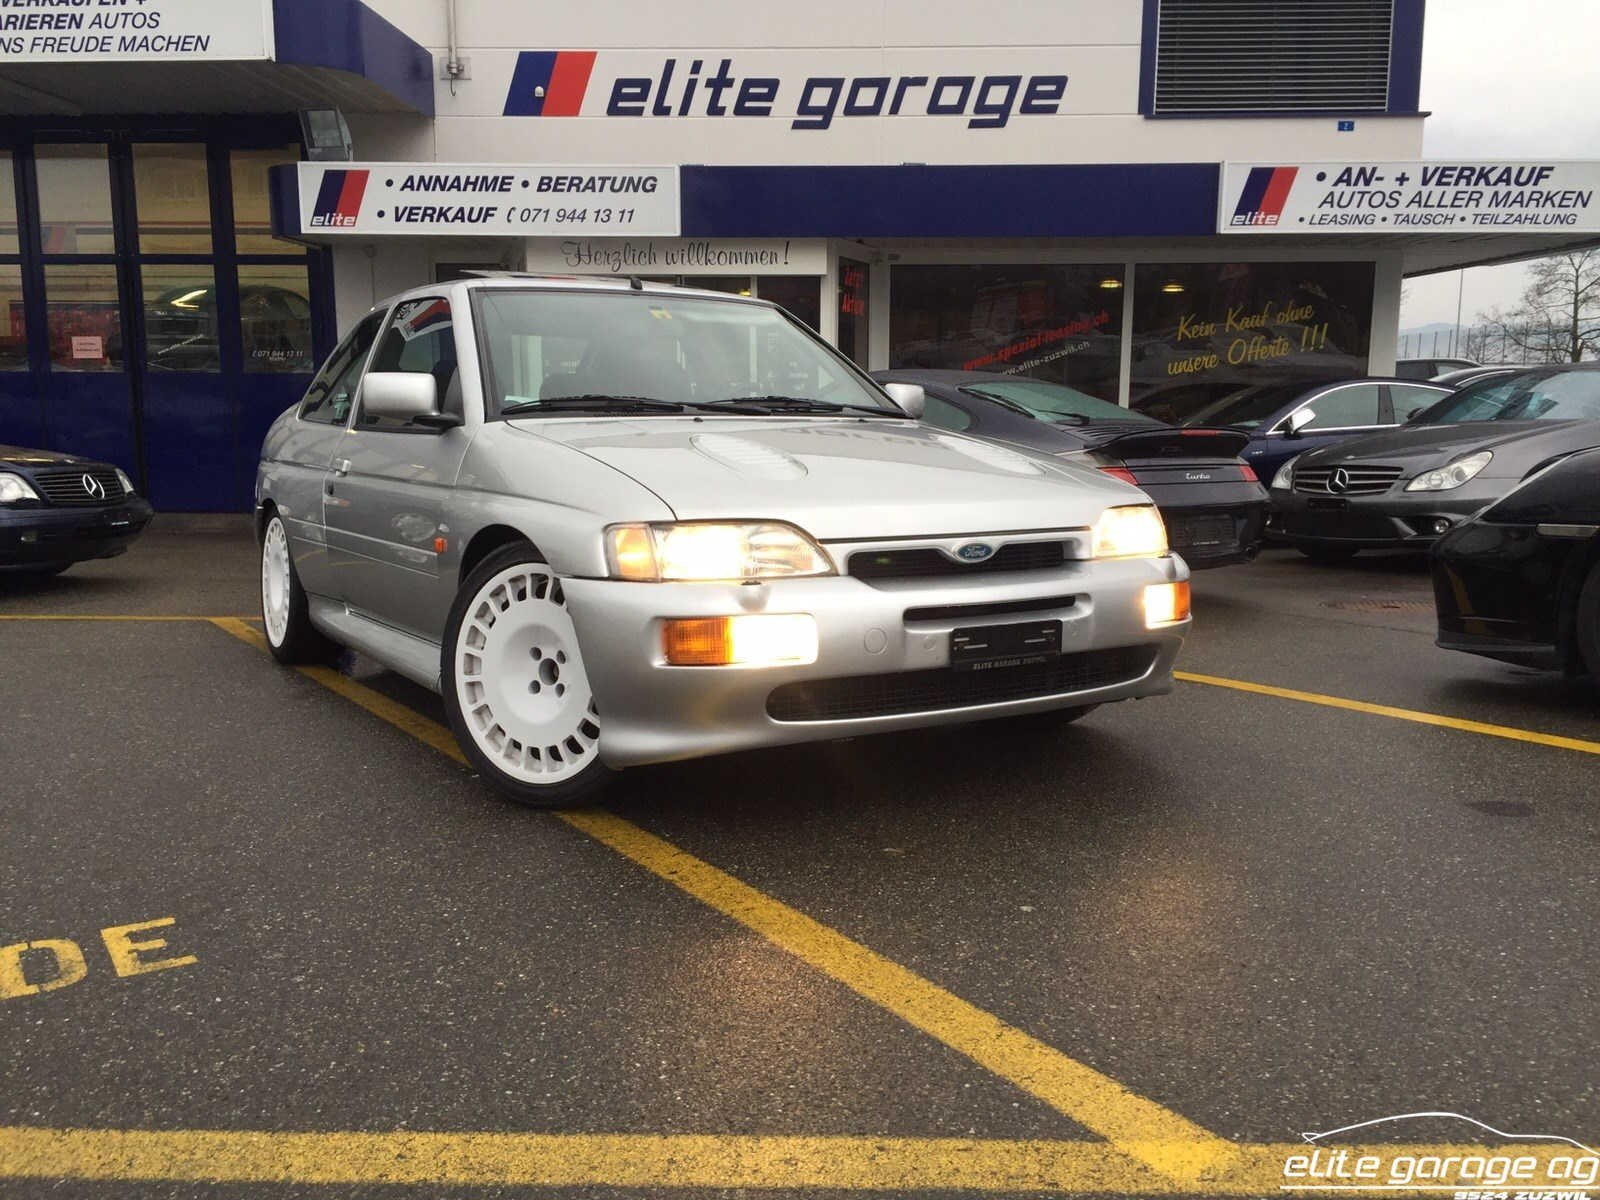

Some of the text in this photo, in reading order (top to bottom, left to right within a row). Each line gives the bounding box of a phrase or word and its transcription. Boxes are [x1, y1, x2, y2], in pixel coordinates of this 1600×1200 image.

[0, 12, 160, 30] RIEREN AUTOS
[29, 36, 113, 53] FREUDE
[117, 35, 210, 52] MACHEN
[606, 58, 1069, 130] elite garage
[400, 174, 658, 193] ANNAHME BERATUNG
[1332, 166, 1555, 187] AN- + VERKAUF
[1318, 190, 1593, 209] AUTOS ALLER MARKEN
[311, 213, 357, 226] elite
[394, 206, 635, 223] VERKAUF 071 944 13 11
[1231, 211, 1279, 225] elite
[1308, 213, 1578, 225] LEASING TAUSCH TEILZAHLUNG
[560, 240, 657, 272] Herzlich
[1177, 300, 1314, 341] Kein Kauf ohne
[1168, 323, 1329, 375] unsere Offerte !!!
